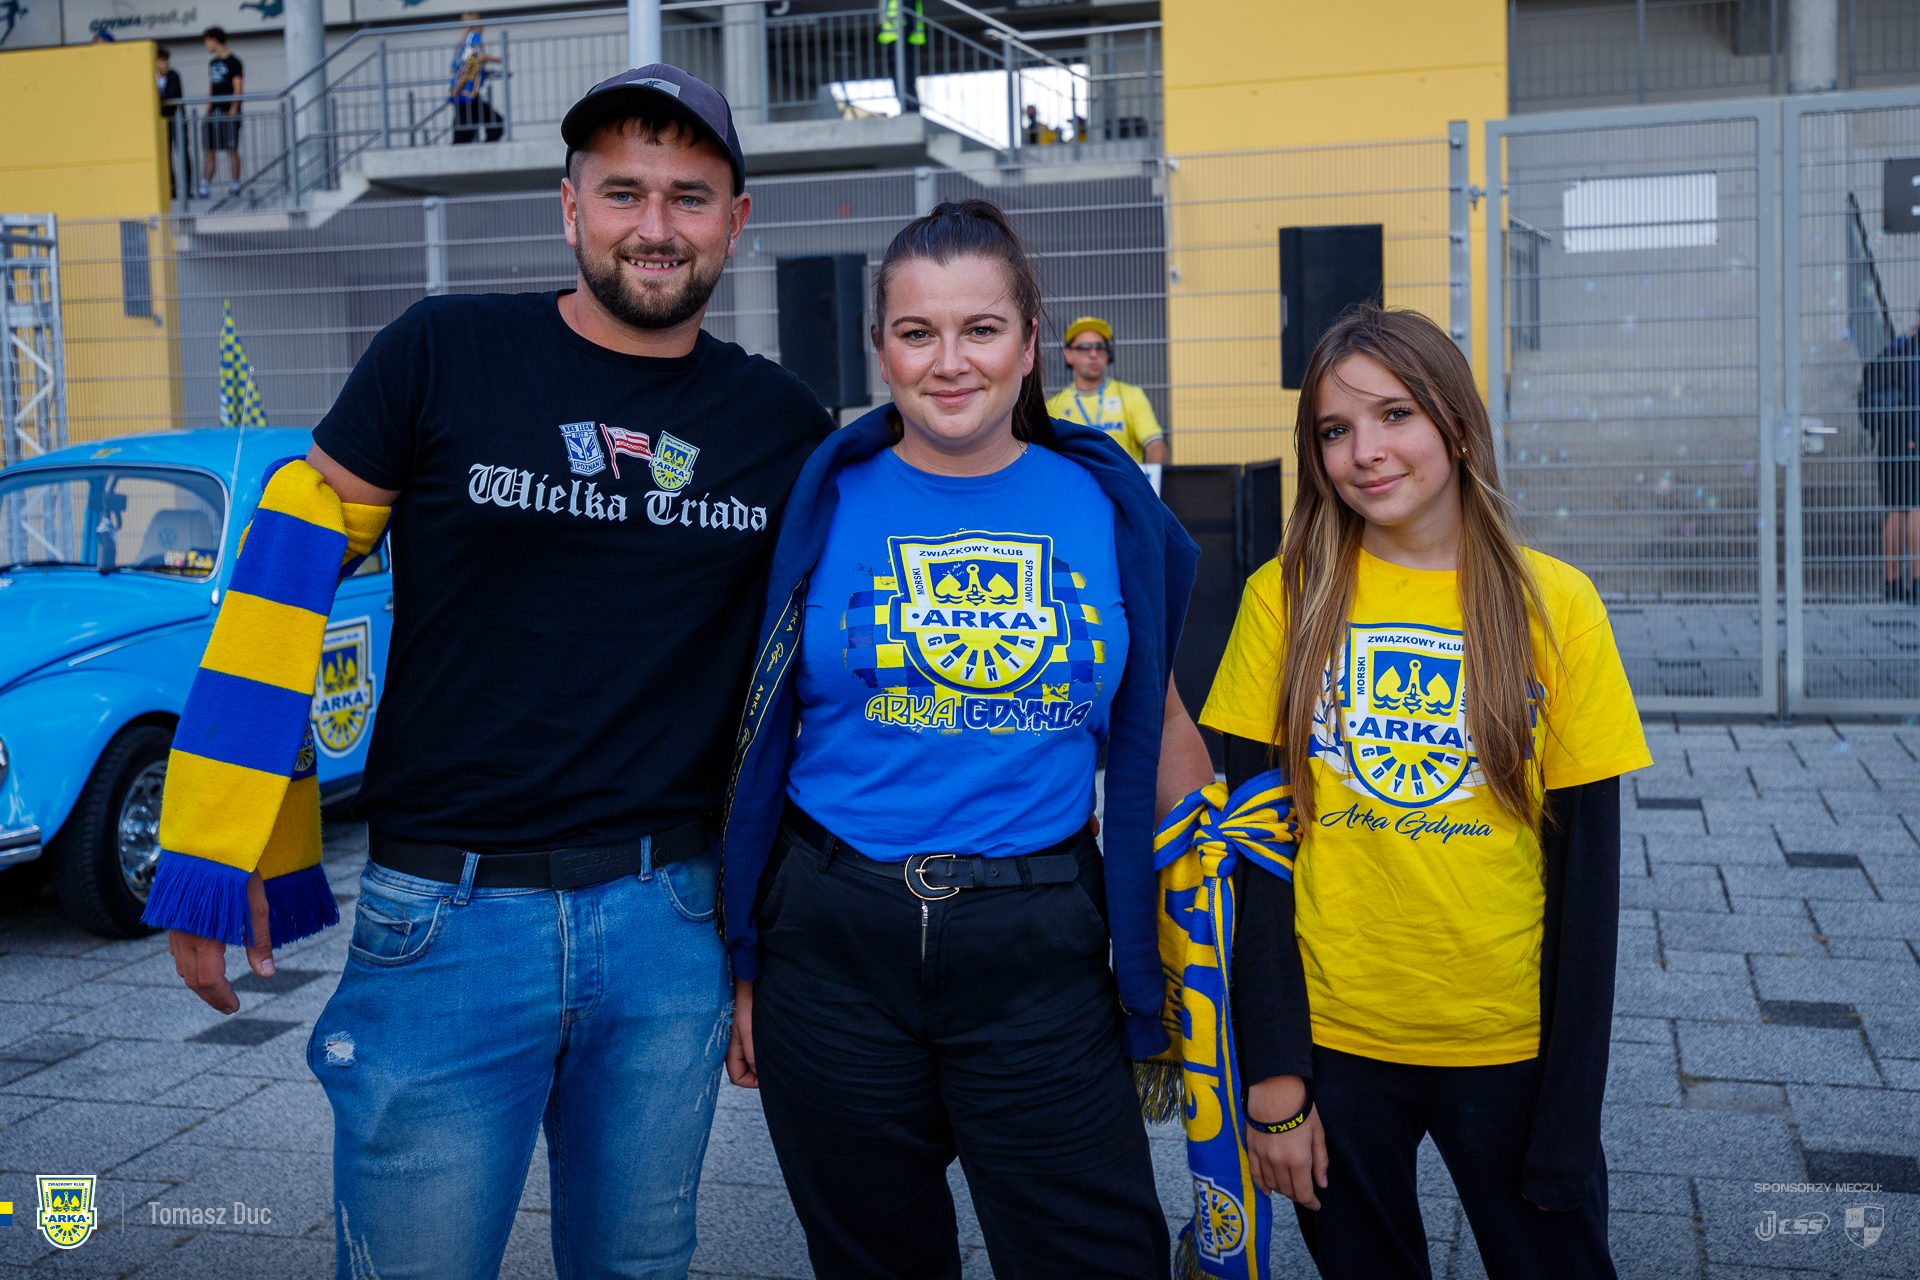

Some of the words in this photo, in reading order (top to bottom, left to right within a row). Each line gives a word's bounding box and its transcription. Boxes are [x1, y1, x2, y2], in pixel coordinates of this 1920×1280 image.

[657, 461, 685, 478] ARKA
[468, 463, 628, 522] Wielka
[644, 490, 768, 531] Triada
[919, 545, 990, 557] ZWIĄZKOWY
[992, 547, 1024, 556] KLUB
[914, 567, 926, 596] MORSKI
[1025, 559, 1034, 603] SPORTOWY
[920, 609, 1038, 630] ARKA
[1367, 635, 1436, 648] ZWIĄZKOWY
[928, 636, 1036, 681] GDYNIA
[1356, 656, 1366, 695] MORSKI
[319, 691, 364, 715] ARKA
[749, 684, 764, 716] ARKA
[865, 693, 957, 728] ARKA
[963, 697, 1093, 731] GDYNIA
[1356, 716, 1464, 749] ARKA
[1361, 746, 1461, 796] GDYNIA
[1320, 803, 1391, 832] Arka
[1395, 810, 1494, 844] Gdynia
[1267, 1113, 1304, 1133] ARKA
[1199, 1191, 1215, 1246] ARKA
